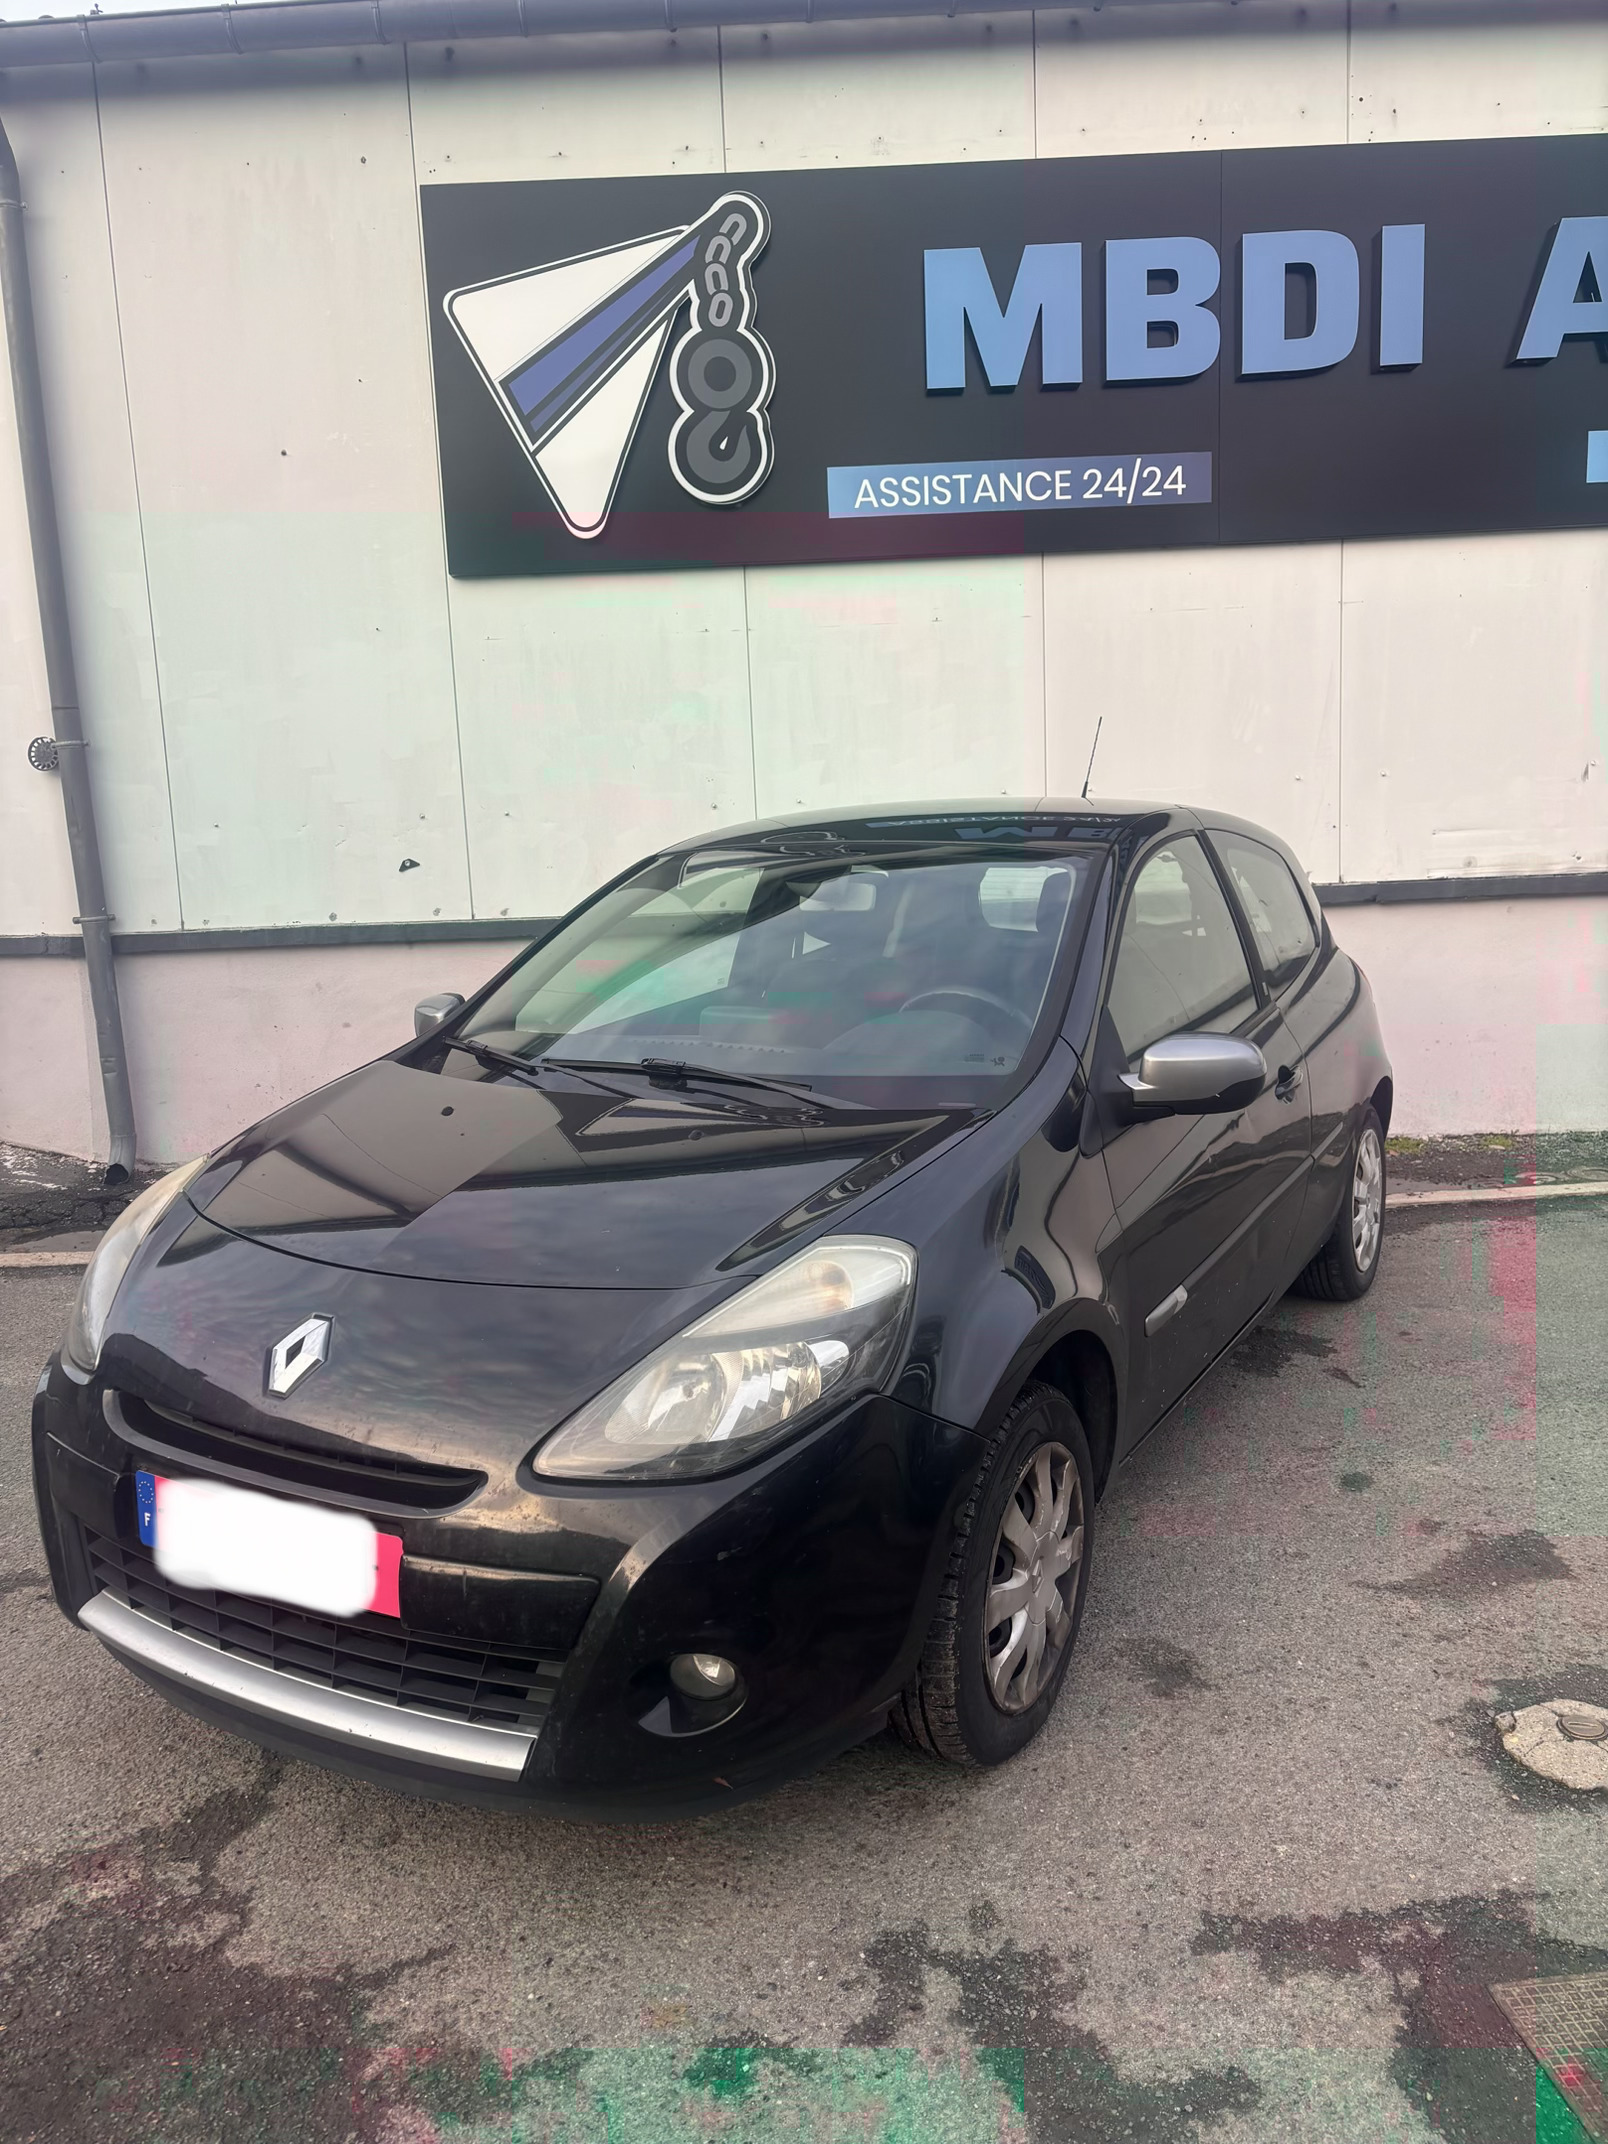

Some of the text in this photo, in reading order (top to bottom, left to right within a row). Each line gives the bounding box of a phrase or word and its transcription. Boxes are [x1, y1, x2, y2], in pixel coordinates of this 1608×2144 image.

[924, 223, 1426, 391] MBDI
[854, 457, 1187, 509] ASSISTANCE 24/24
[144, 1512, 151, 1527] F
